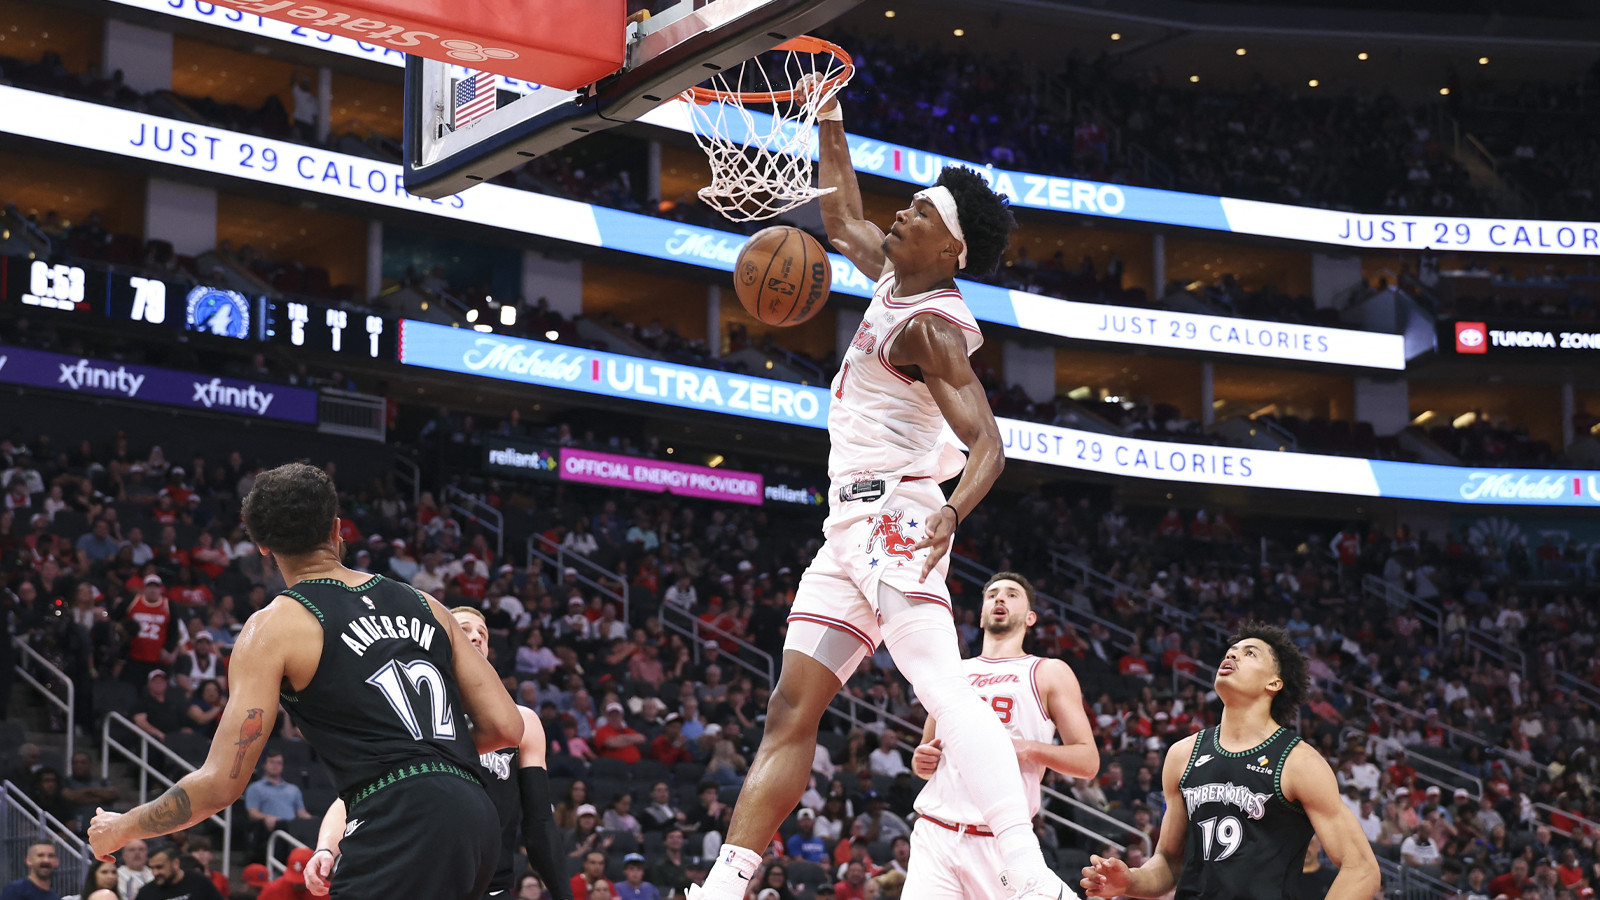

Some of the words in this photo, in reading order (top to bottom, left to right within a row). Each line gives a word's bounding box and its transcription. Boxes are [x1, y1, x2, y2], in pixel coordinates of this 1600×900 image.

[129, 123, 222, 161] JUST
[239, 143, 278, 172] 29
[1023, 175, 1126, 215] ZERO
[1338, 218, 1417, 243] JUST
[1434, 222, 1471, 245] 29
[1098, 313, 1157, 336] JUST
[1170, 320, 1198, 340] 29
[1209, 325, 1330, 354] CALORIES
[1489, 330, 1557, 348] TUNDRA
[58, 359, 145, 397] xfinity
[192, 378, 274, 415] xfinity
[462, 338, 586, 382] Michelob
[606, 359, 724, 405] ULTRA
[727, 379, 820, 420] ZERO
[489, 448, 540, 470] reliant
[1003, 427, 1064, 457] JUST
[1076, 439, 1103, 462] 29
[1114, 445, 1254, 478] CALORIES
[565, 457, 632, 481] OFFICIAL
[633, 466, 691, 490] ENERGY
[690, 472, 758, 497] PROVIDER
[1459, 472, 1567, 500] Michelob
[341, 615, 436, 657] ANDERSON
[365, 658, 457, 741] 12
[980, 695, 1016, 725] 8
[1246, 763, 1273, 775] sezzle
[1182, 782, 1274, 821] TIMBERWOLVES
[1197, 815, 1243, 862] 19
